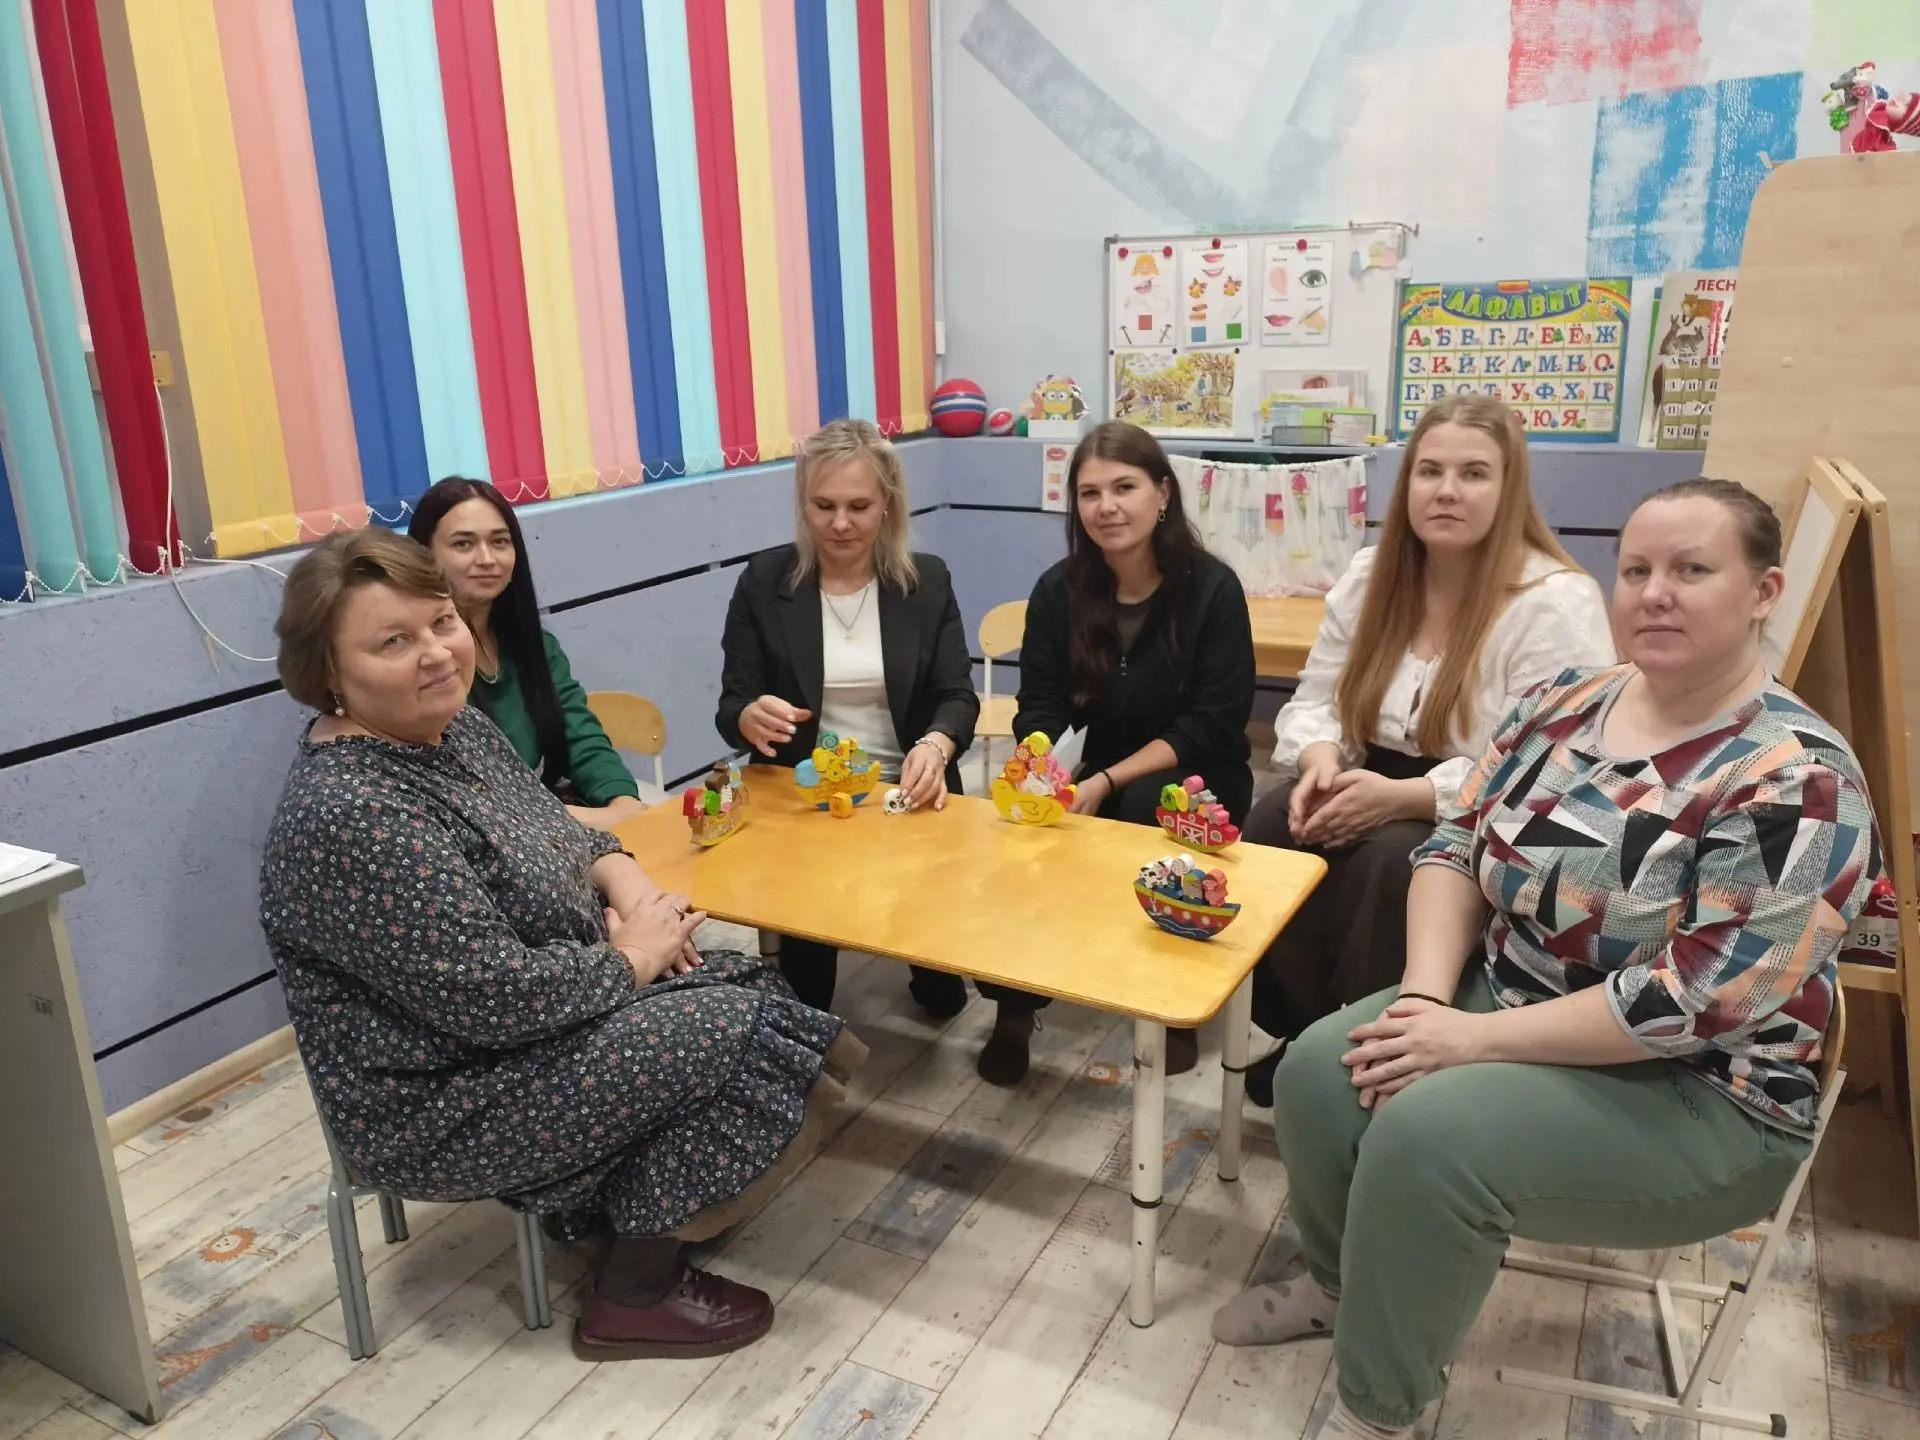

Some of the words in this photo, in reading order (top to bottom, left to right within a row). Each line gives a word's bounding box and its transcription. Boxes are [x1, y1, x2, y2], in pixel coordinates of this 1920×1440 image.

[1446, 283, 1582, 319] АЛФАВИТ
[1408, 329, 1424, 347] А
[1437, 330, 1451, 346] Б
[1461, 329, 1474, 345] В
[1488, 329, 1502, 345] Г
[1513, 328, 1529, 345] Д
[1541, 327, 1554, 344] Е
[1568, 324, 1583, 343] Ё
[1596, 326, 1617, 343] Ж
[1432, 357, 1447, 373] И
[1485, 356, 1499, 373] К
[1511, 356, 1526, 373] Л
[1538, 355, 1558, 372] М
[1566, 354, 1584, 372] Н
[1594, 354, 1611, 371] О
[1405, 384, 1421, 400] П
[1432, 384, 1445, 400] Р
[1511, 383, 1526, 400] У
[1536, 383, 1554, 399] Ф
[1564, 383, 1580, 399] Х
[1593, 382, 1610, 402] Ц
[1405, 410, 1418, 425] Ч
[1534, 410, 1552, 427] Ю
[1562, 410, 1579, 426] Я
[1857, 933, 1880, 947] 39
